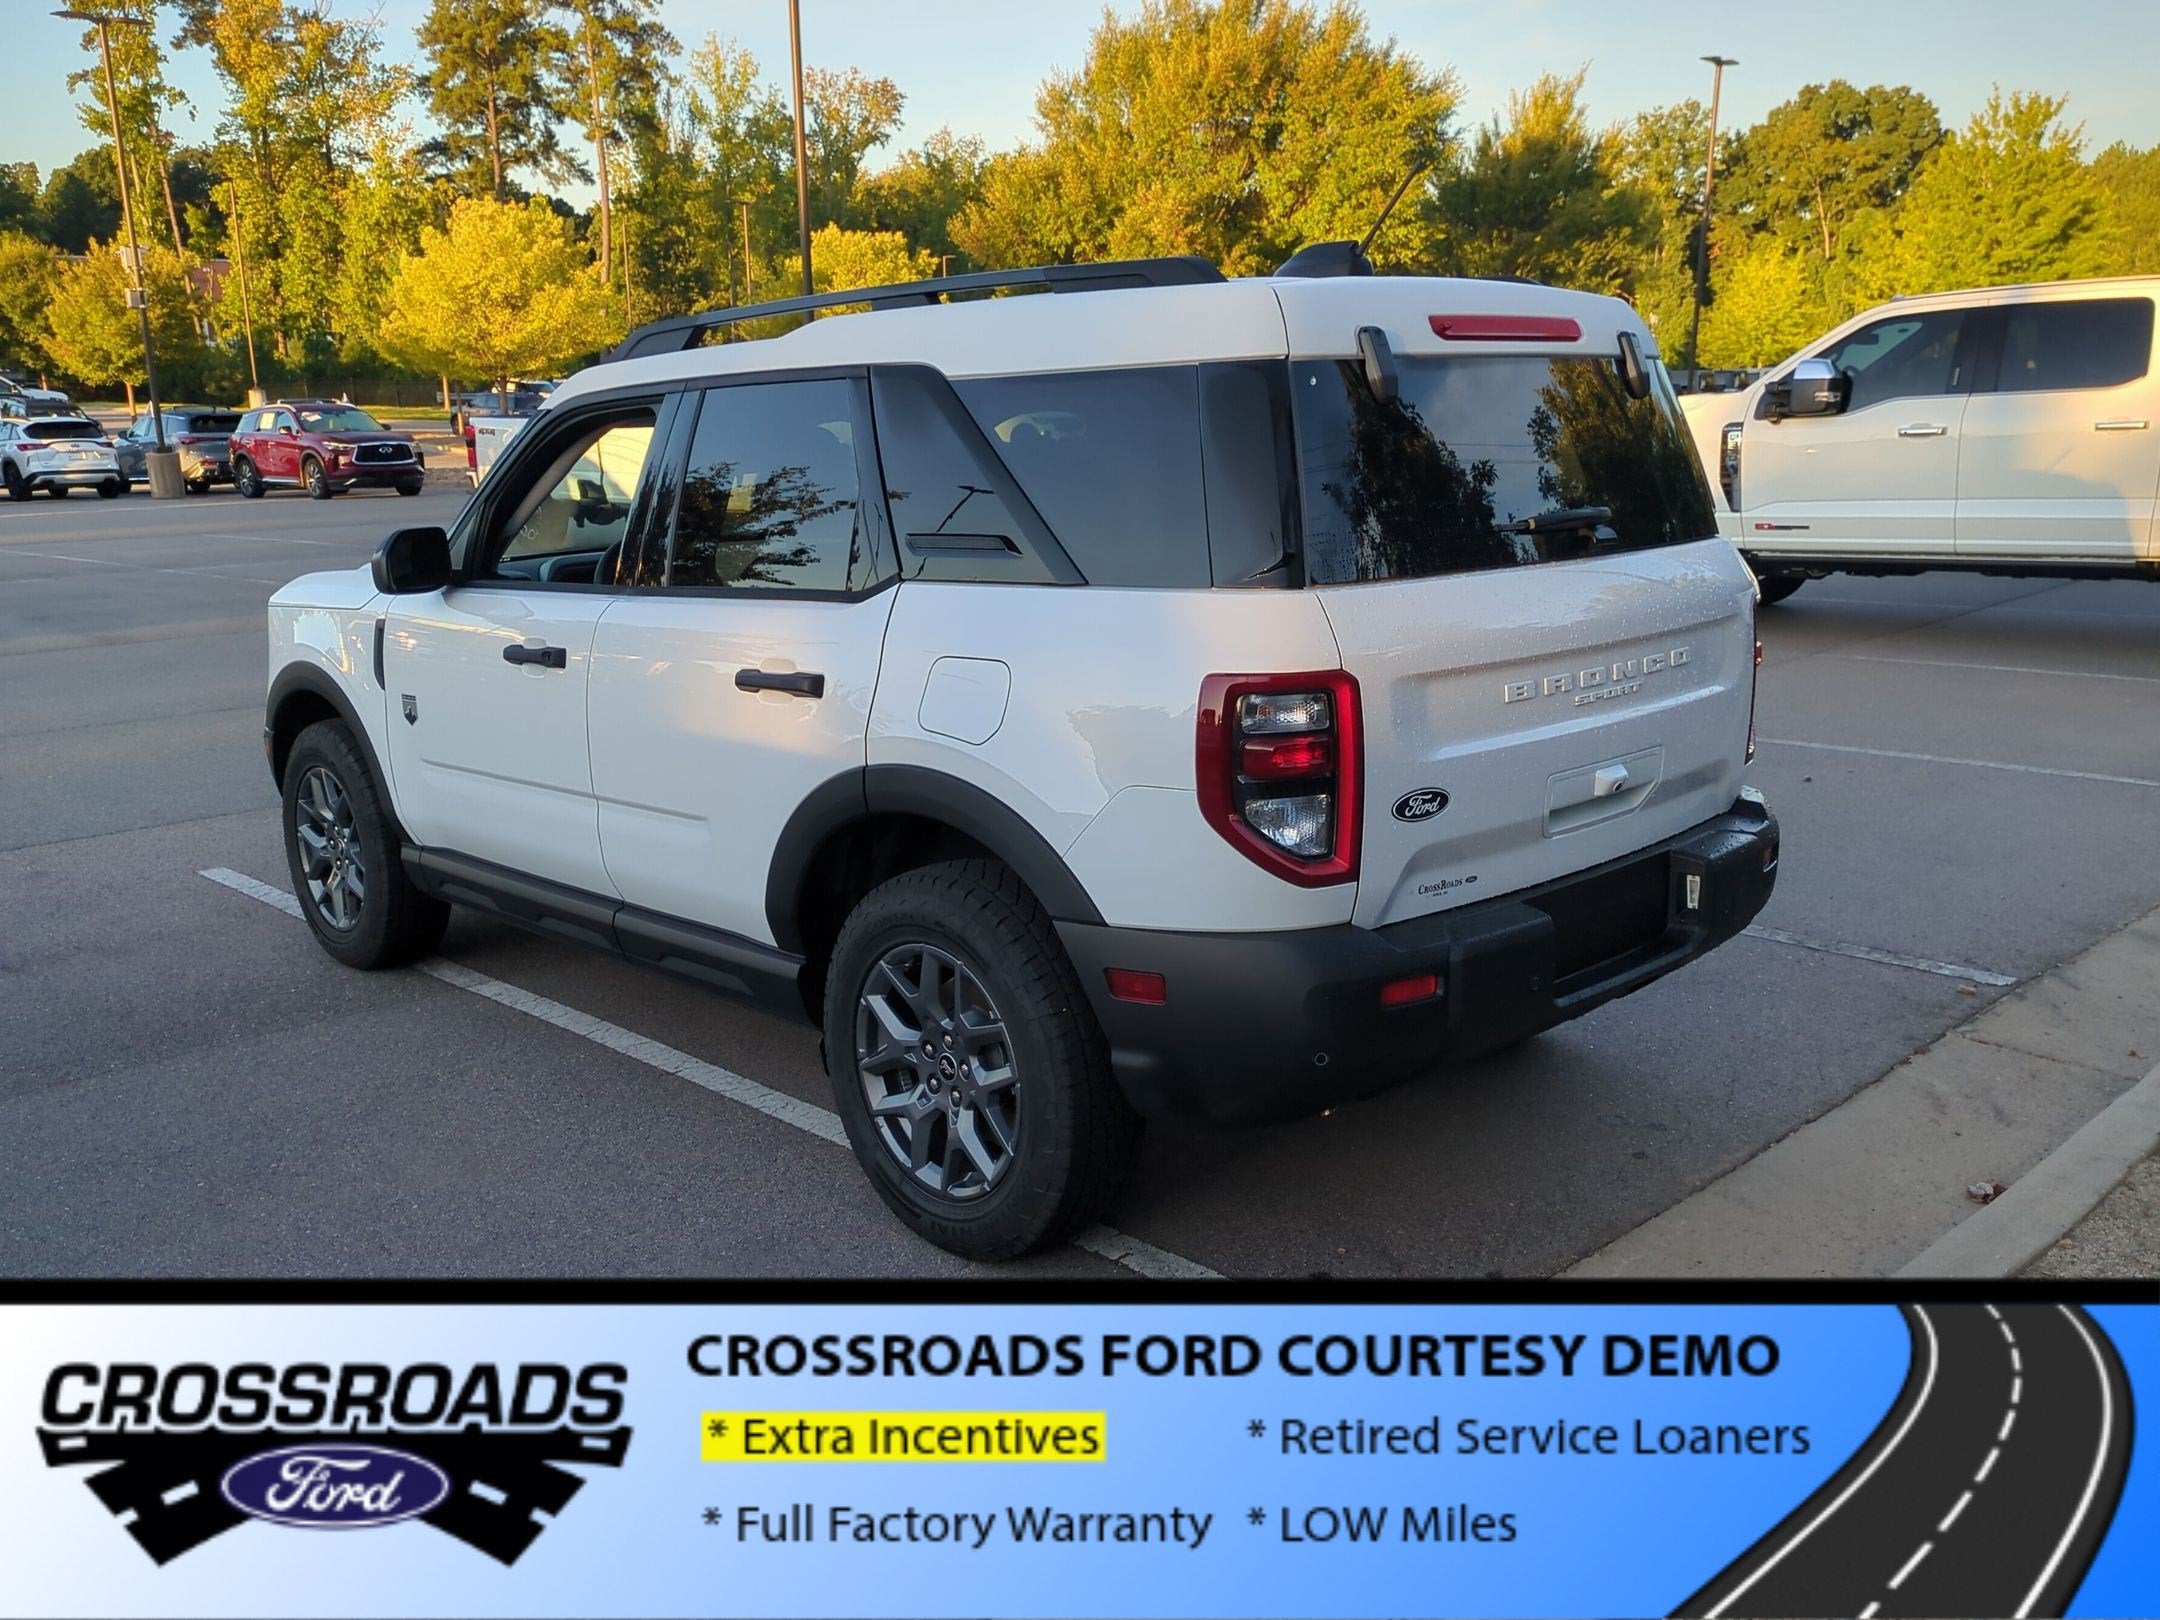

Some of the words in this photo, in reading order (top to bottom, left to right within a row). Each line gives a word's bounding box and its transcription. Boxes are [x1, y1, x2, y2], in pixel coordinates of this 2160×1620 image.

[1504, 647, 1690, 703] BRONCO
[1574, 680, 1643, 706] SPORT
[1405, 794, 1441, 817] Ford
